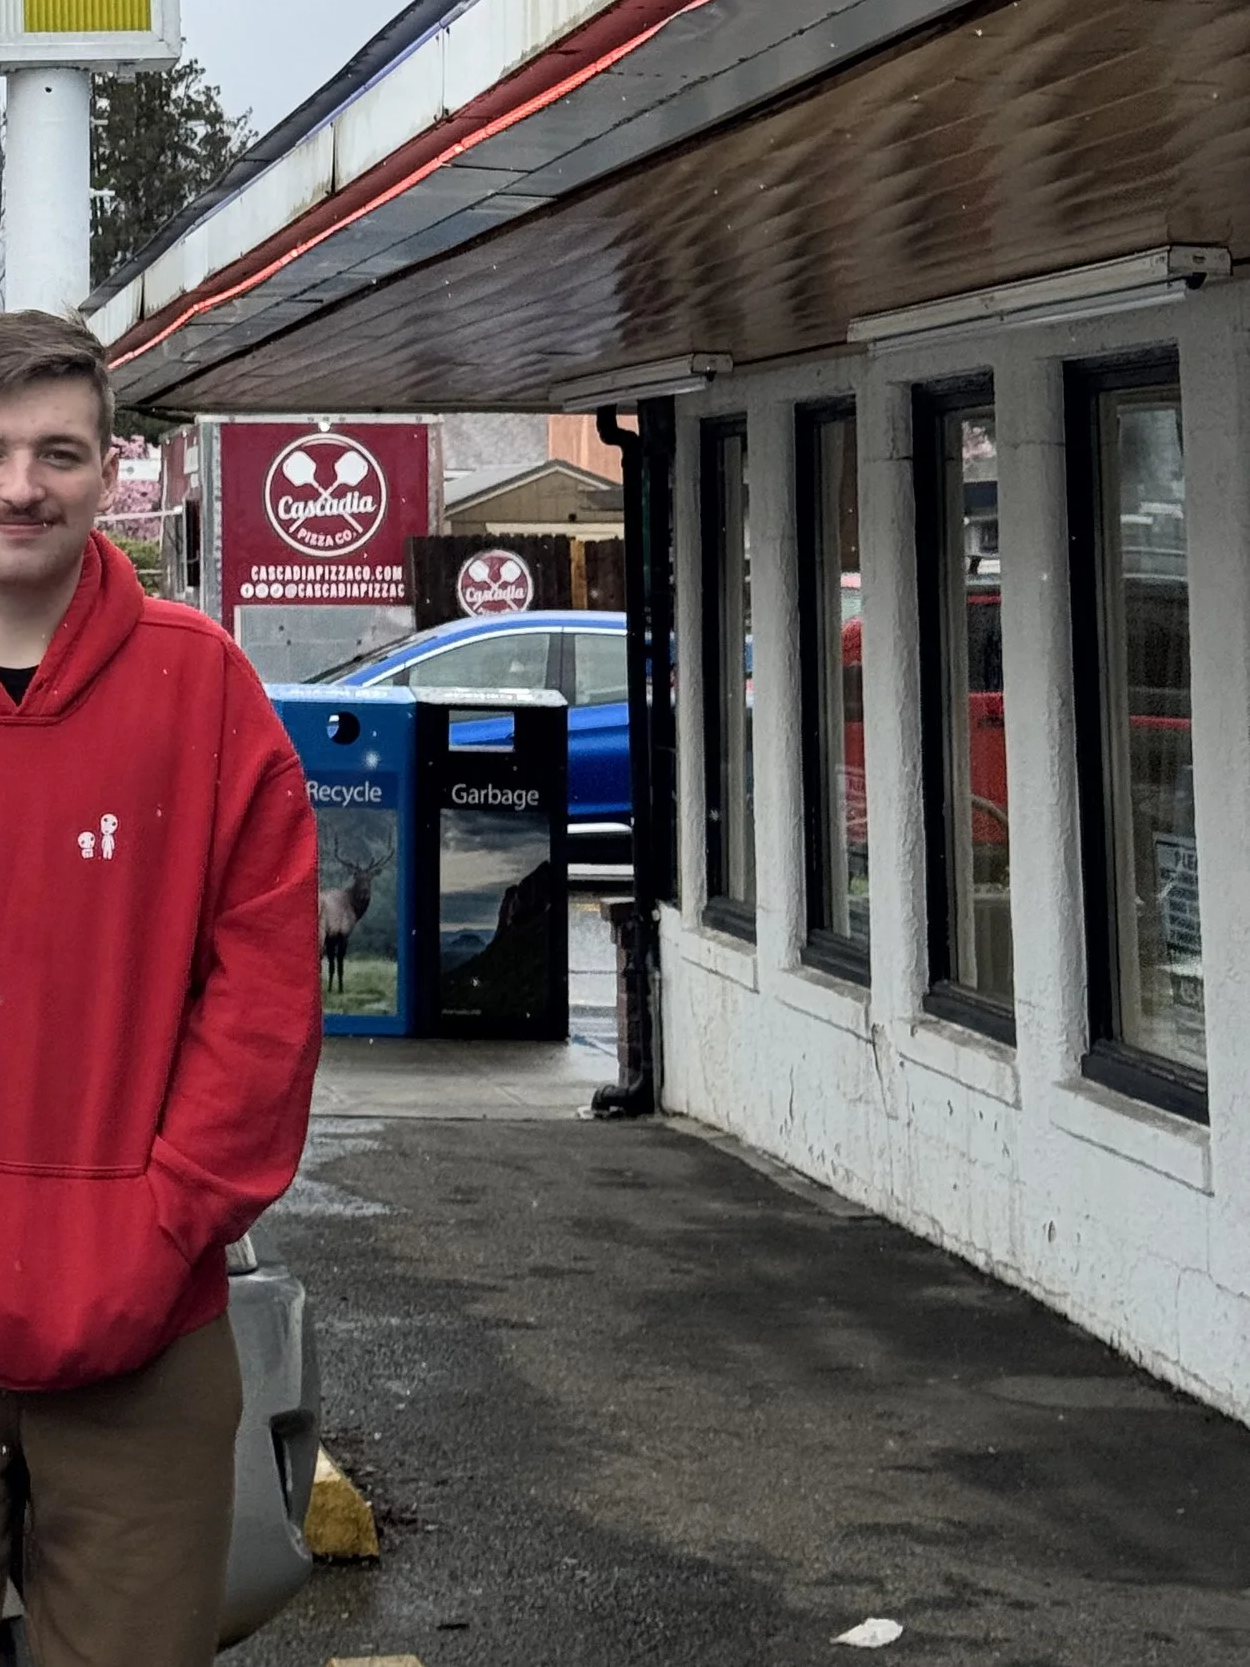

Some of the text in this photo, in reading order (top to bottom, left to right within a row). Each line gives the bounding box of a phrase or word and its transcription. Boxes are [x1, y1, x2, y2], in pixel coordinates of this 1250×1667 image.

[278, 490, 377, 521] Cascadia
[296, 528, 334, 547] PIZZA
[251, 565, 403, 582] CASCADIAPIZZACO.COM
[306, 781, 540, 811] Recycle Garbage
